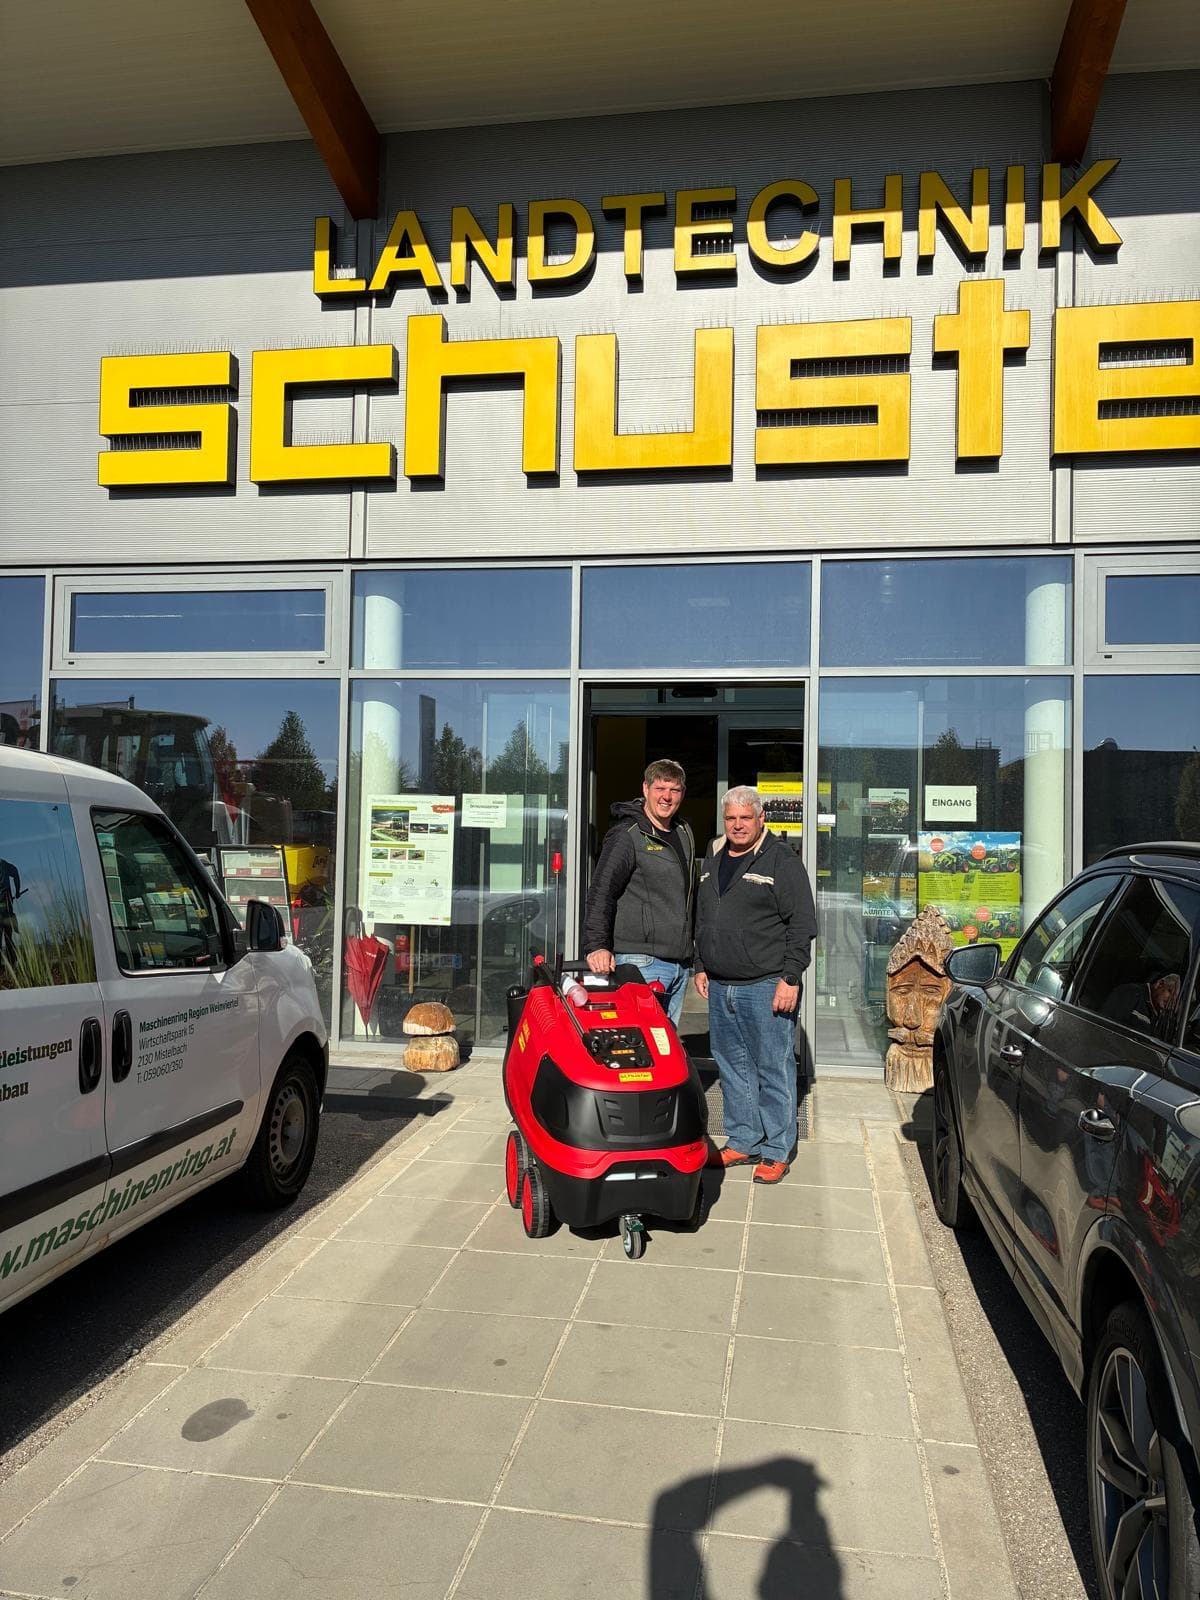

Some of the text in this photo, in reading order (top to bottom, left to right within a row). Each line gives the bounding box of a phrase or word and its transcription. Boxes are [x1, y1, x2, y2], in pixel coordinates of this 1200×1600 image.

[313, 158, 1122, 298] LANDTECHNIK
[931, 799, 972, 808] EINGANG
[139, 997, 239, 1033] Maschinenring Region Weinviertel
[138, 1024, 195, 1051] Wirtschaftspark 15
[137, 1043, 187, 1067] 2130 Mistelbach
